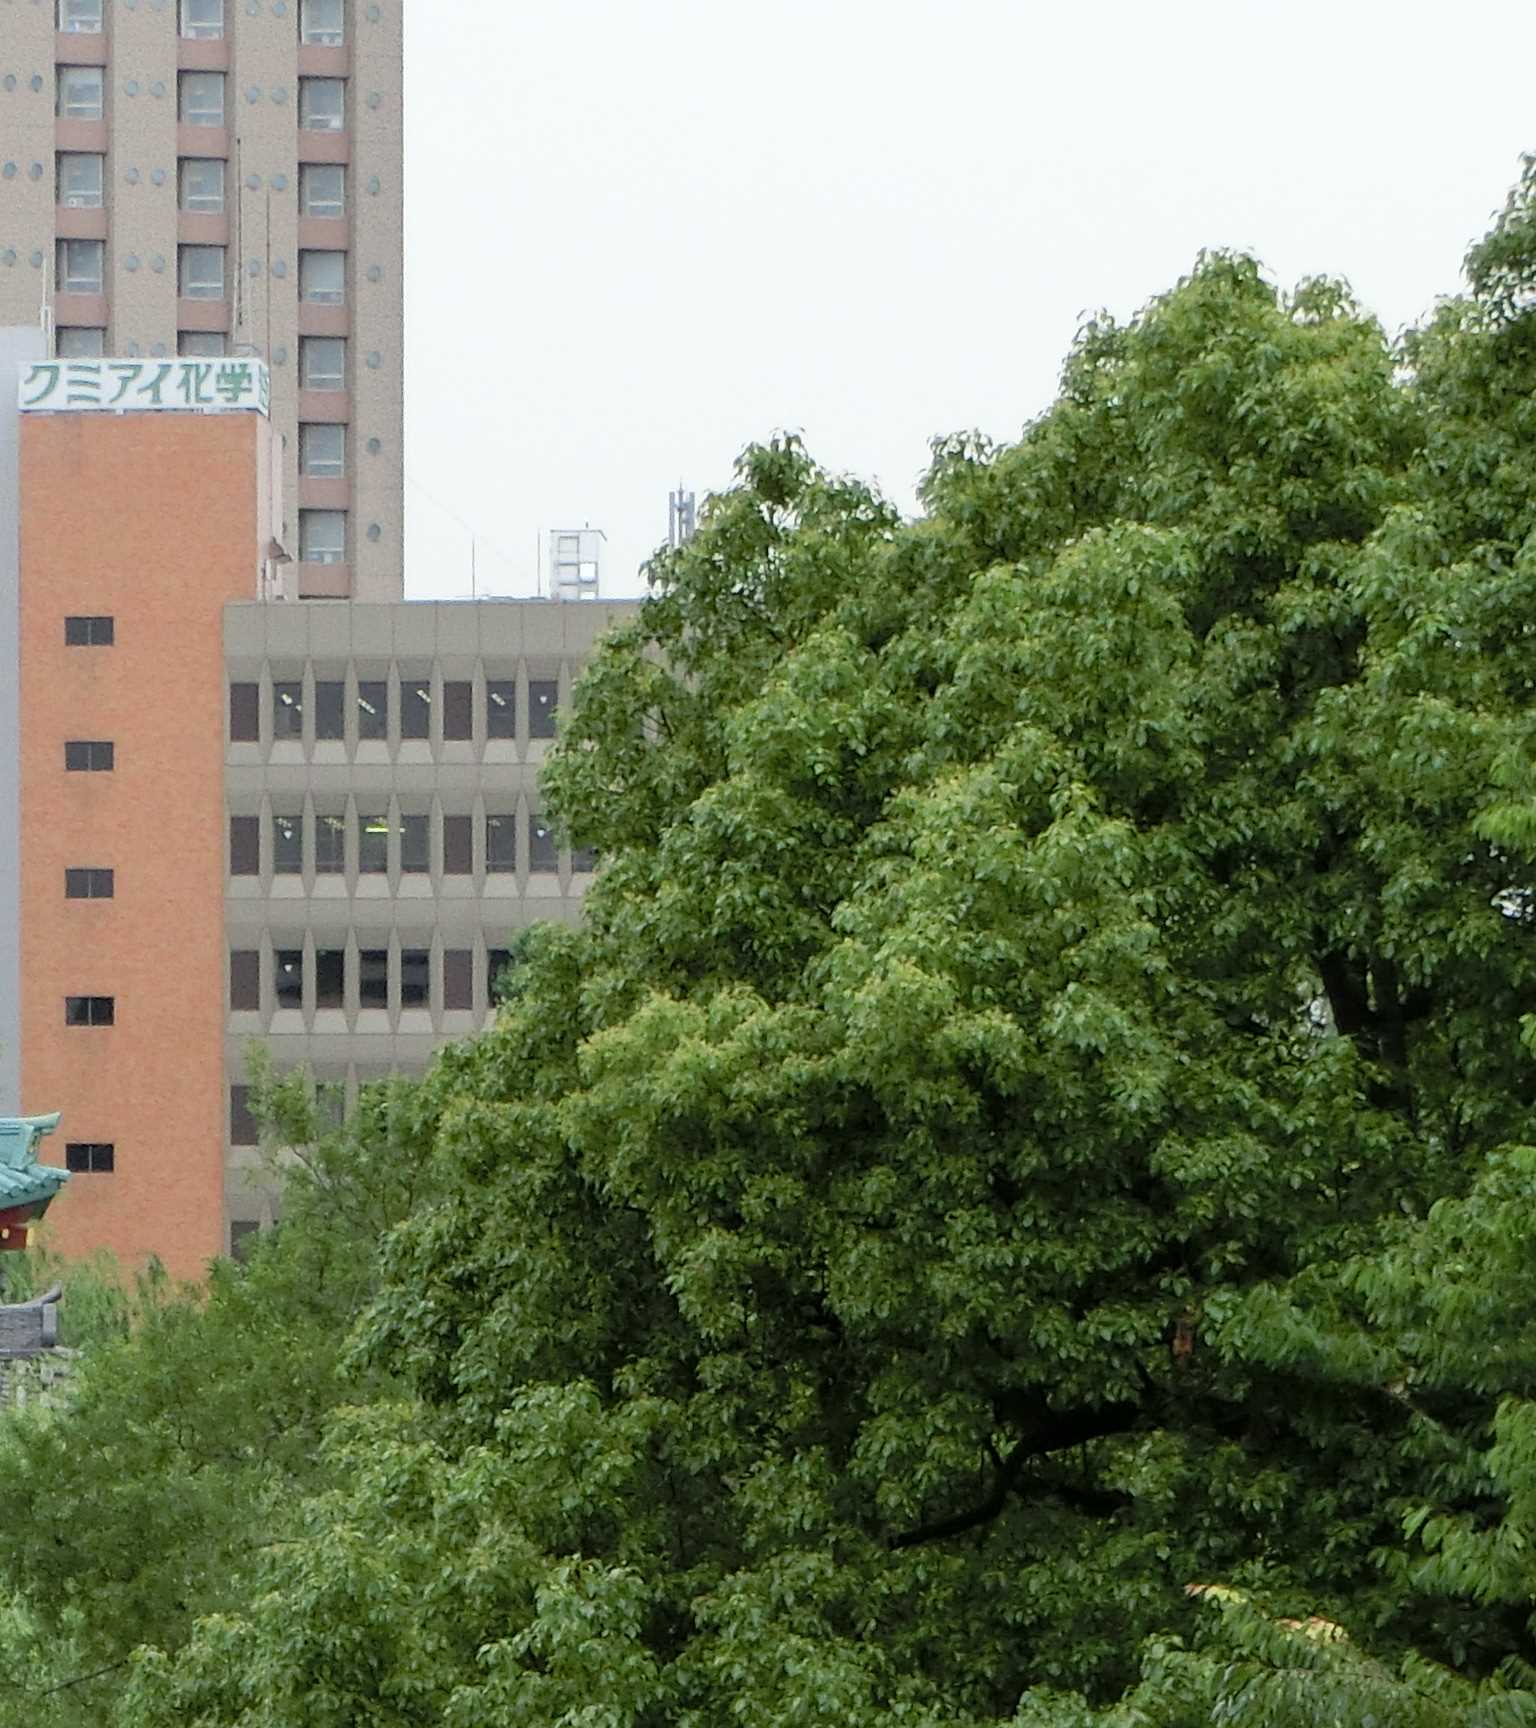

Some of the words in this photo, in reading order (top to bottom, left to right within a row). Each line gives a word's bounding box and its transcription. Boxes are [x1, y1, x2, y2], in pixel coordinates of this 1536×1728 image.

[23, 362, 253, 404] クミアイ化学
